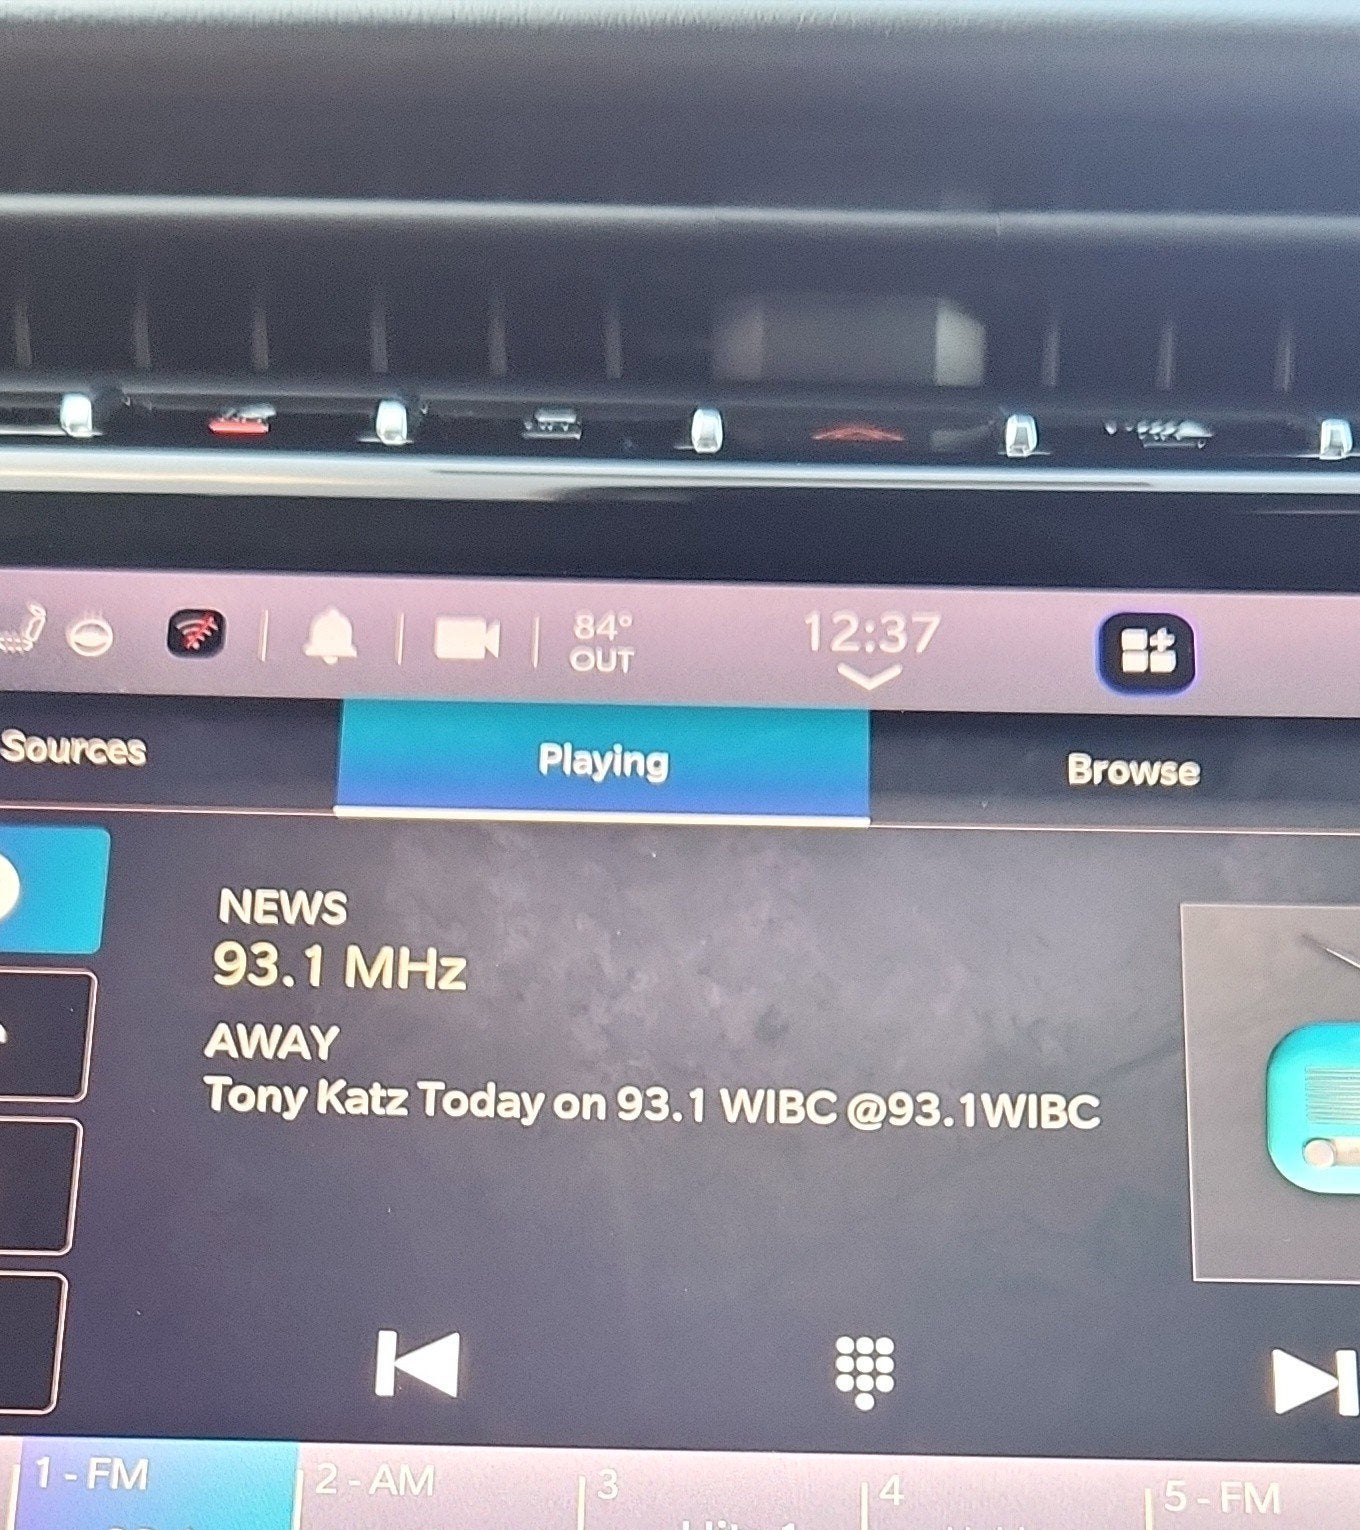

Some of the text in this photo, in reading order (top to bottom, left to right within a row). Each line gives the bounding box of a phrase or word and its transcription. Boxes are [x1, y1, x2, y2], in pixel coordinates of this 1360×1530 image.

[805, 611, 941, 654] 12:37
[569, 647, 635, 674] OUT
[0, 728, 147, 766] Sources
[539, 742, 669, 785] Playing
[1068, 752, 1201, 787] Browse
[219, 887, 347, 926] NEWS
[213, 941, 467, 991] 93.1 MHz
[203, 1022, 340, 1061] AWAY
[202, 1075, 1101, 1131] Tony Katz Today on 93.1 WIBC @93.1WIBC
[36, 1456, 50, 1488] 1
[86, 1457, 148, 1491] FM
[314, 1462, 337, 1494] 2
[368, 1464, 434, 1496] AM
[597, 1469, 618, 1500] 3
[879, 1475, 905, 1506] 4
[1164, 1480, 1187, 1512] 5
[1221, 1481, 1281, 1515] FM
